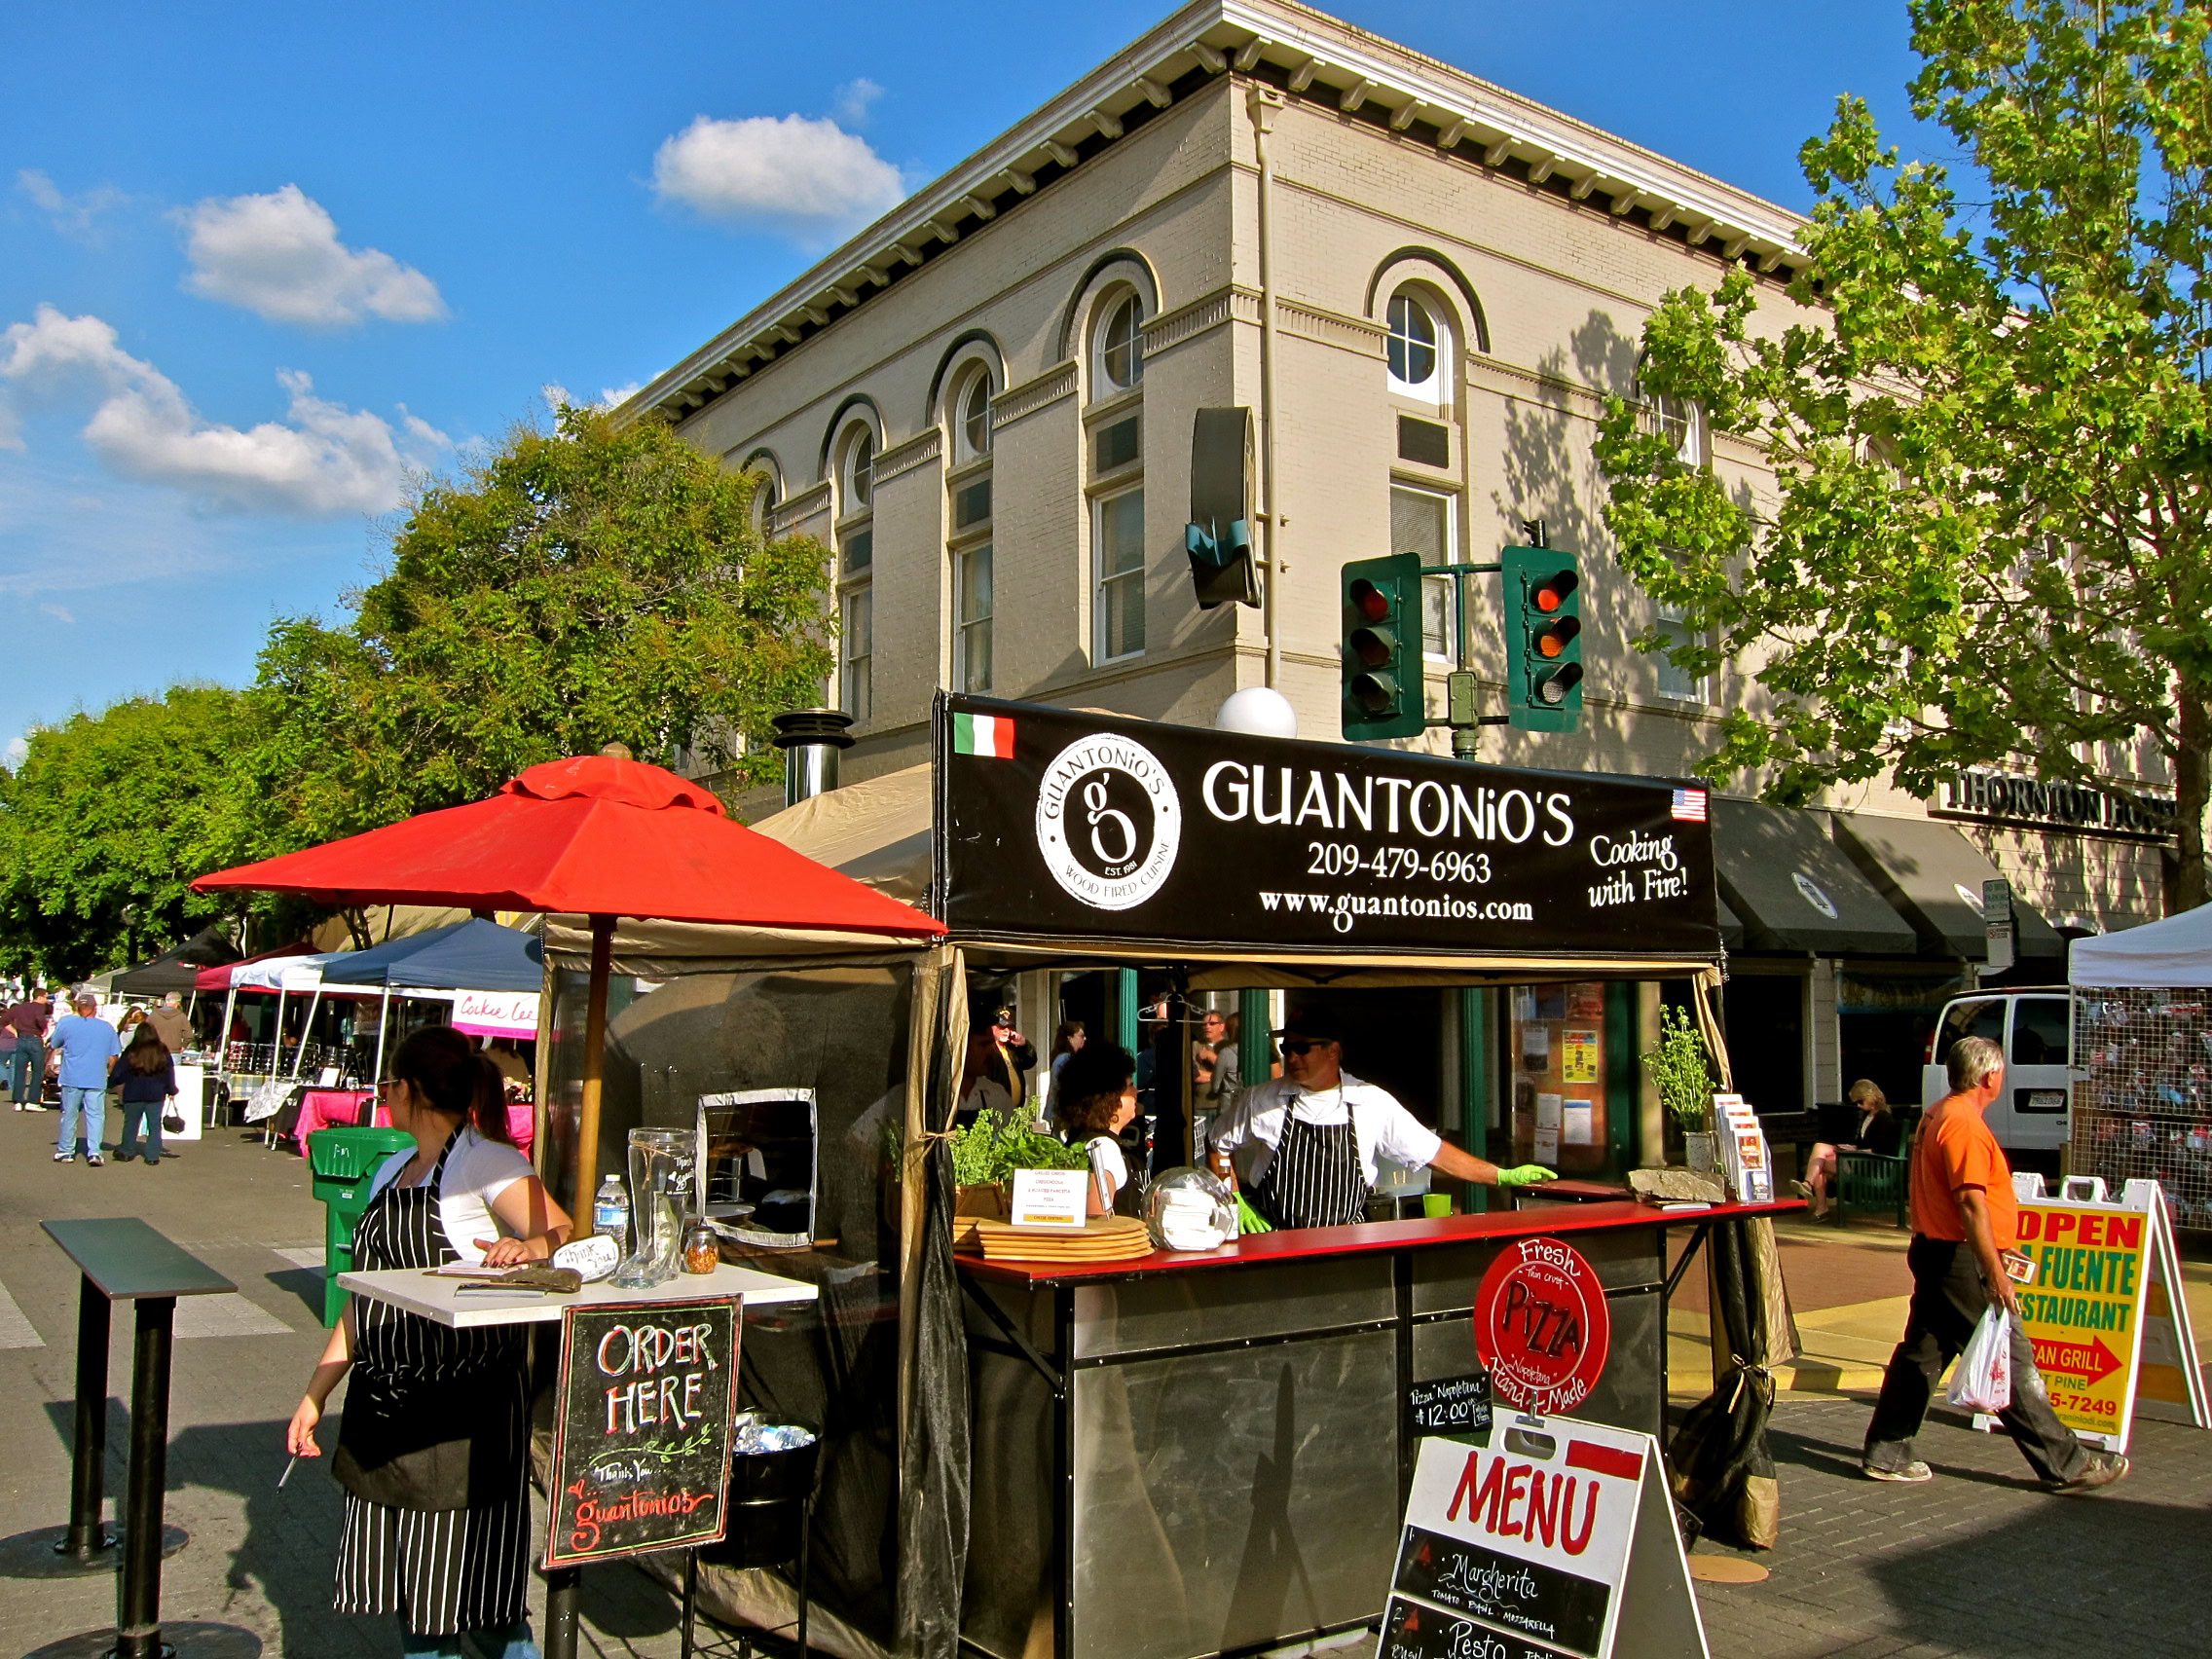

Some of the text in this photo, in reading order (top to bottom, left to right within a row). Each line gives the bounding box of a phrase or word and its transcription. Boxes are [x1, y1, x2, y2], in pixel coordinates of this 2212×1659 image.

[1065, 840, 1170, 898] WOOD FIRED CUISINE
[1104, 861, 1138, 876] EST. 1981
[1307, 841, 1492, 884] 209-479-6963
[1590, 830, 1678, 871] Cooking
[1588, 866, 1688, 907] with Fire!
[1258, 892, 1534, 933] www.guantonios.com
[2016, 1210, 2141, 1248] OPEN
[558, 1243, 600, 1264] Thank
[1519, 1238, 1582, 1277] Fresh
[2038, 1245, 2137, 1296] FUENTE
[2016, 1291, 2131, 1333] STAURANT
[597, 1322, 719, 1377] ORDER
[2060, 1347, 2103, 1372] GRILL
[606, 1371, 705, 1435] HERE
[1410, 1389, 1434, 1406] Pizza
[1542, 1376, 1588, 1415] Made
[2054, 1375, 2086, 1391] PINE
[2048, 1391, 2117, 1417] 5-7249
[594, 1461, 634, 1481] Thank
[1446, 1450, 1600, 1557] MENU
[1437, 1553, 1540, 1604] Margherita
[1431, 1589, 1460, 1605] TOMATO
[1502, 1611, 1556, 1640] MOZZARELLA
[1449, 1621, 1507, 1659] Pesto
